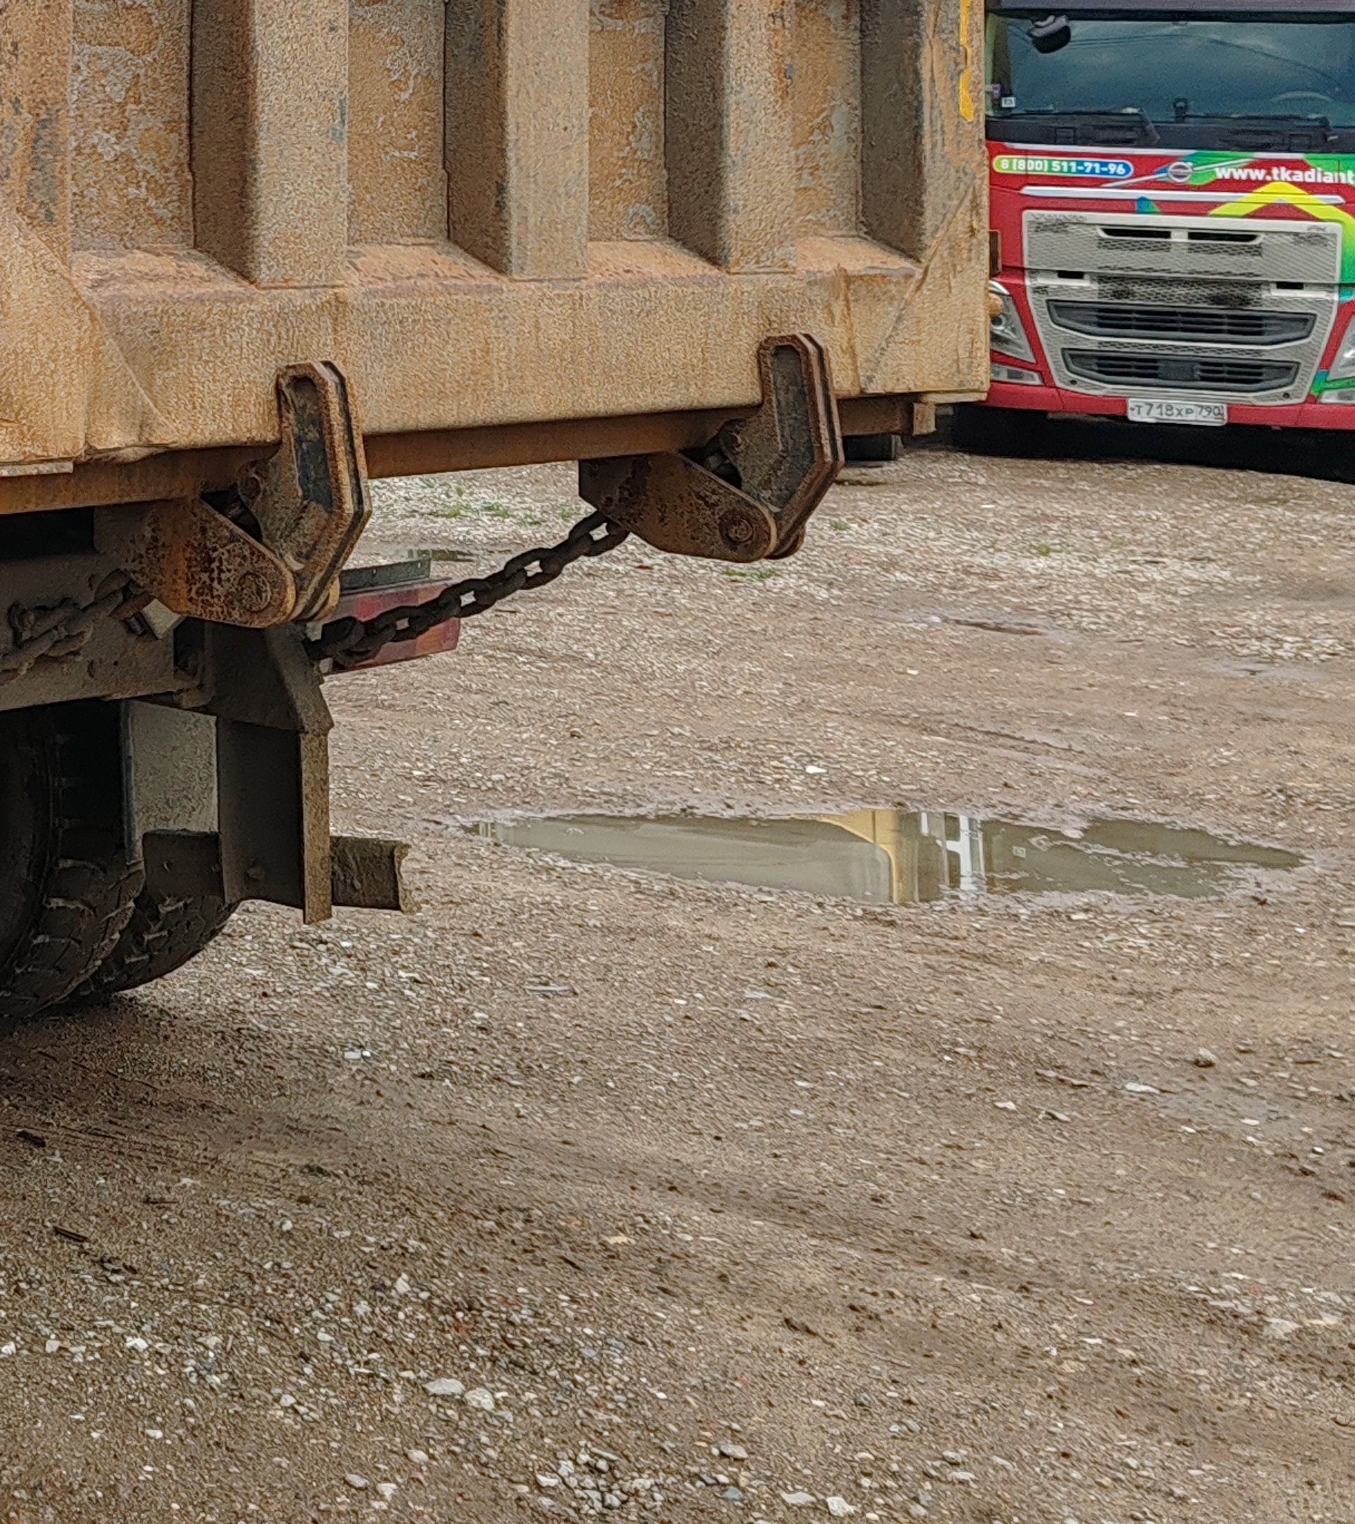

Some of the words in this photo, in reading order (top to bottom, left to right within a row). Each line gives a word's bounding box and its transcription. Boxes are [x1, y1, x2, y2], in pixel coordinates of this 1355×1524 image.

[1000, 159, 1010, 170] 8
[1012, 158, 1049, 169] (800)
[1051, 160, 1127, 175] 511-71-96
